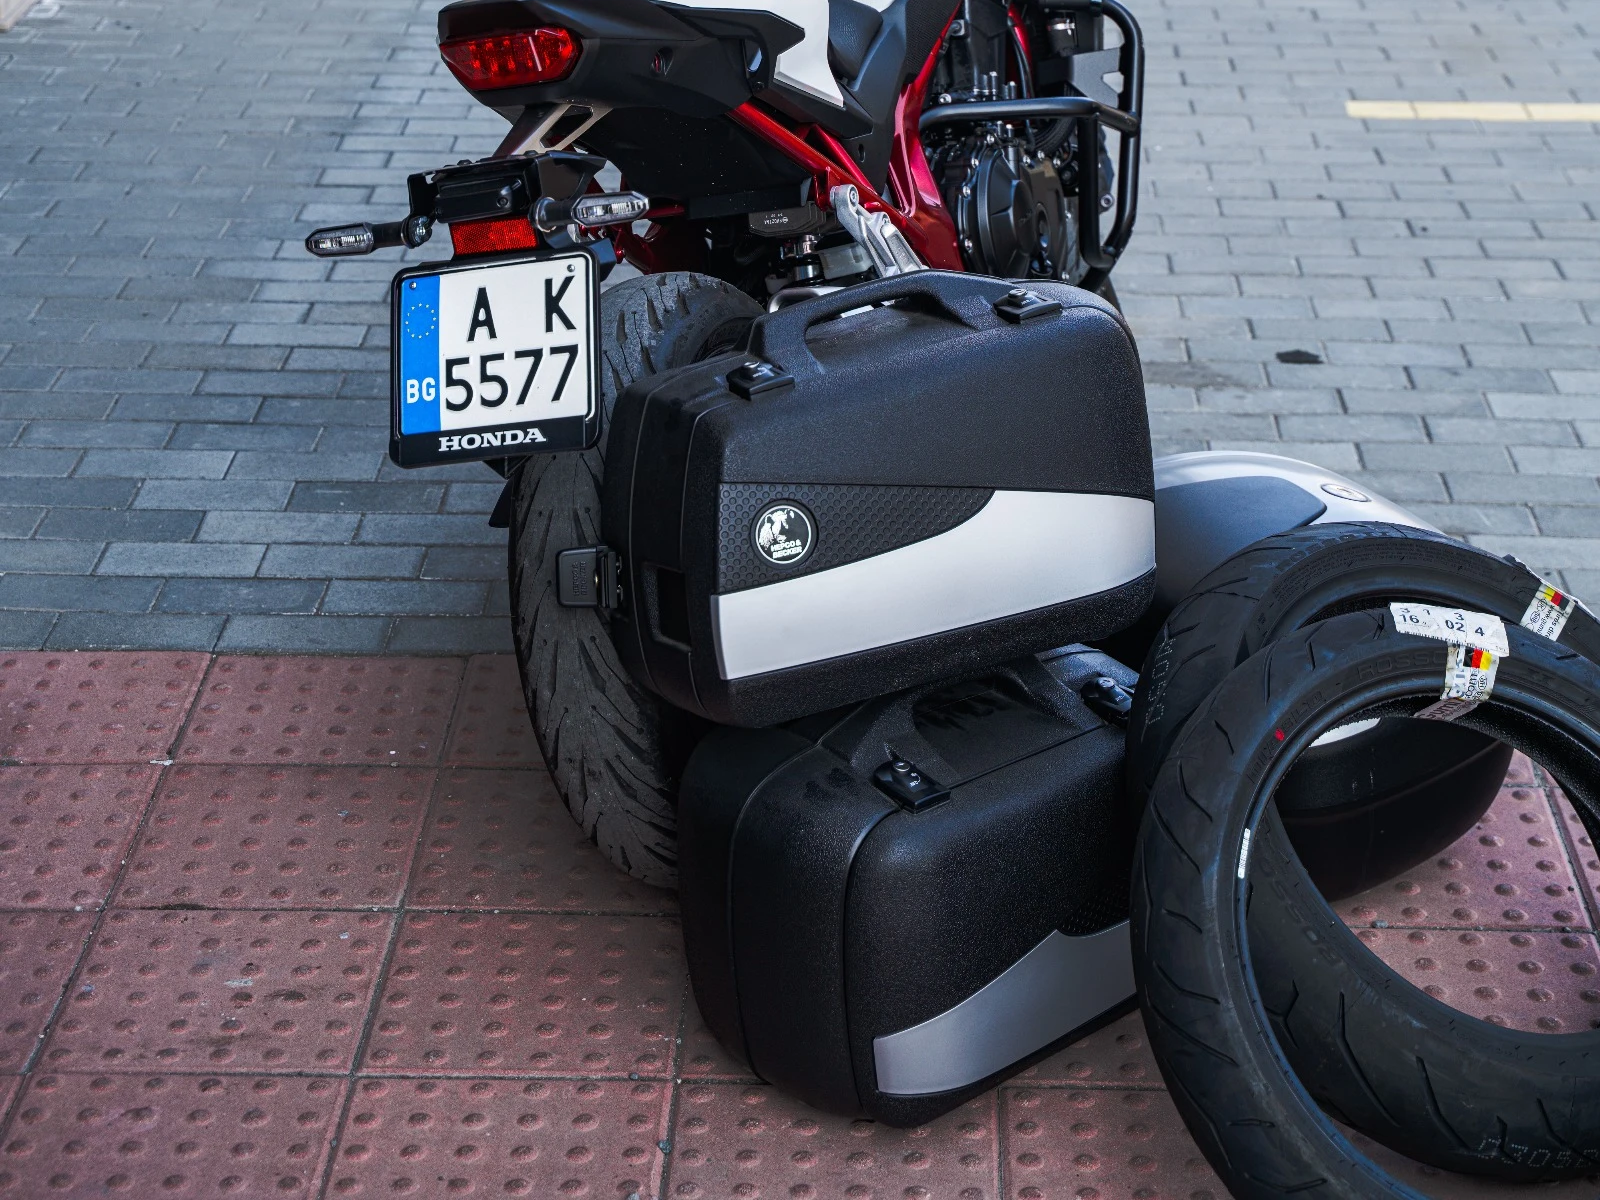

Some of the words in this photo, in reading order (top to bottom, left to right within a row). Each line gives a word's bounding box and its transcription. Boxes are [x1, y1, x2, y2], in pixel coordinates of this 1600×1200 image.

[467, 287, 497, 342] A
[545, 275, 576, 333] K
[445, 344, 578, 412] 5577
[406, 377, 436, 404] BG
[439, 428, 546, 451] HONDA
[771, 540, 795, 552] HEPCO
[773, 546, 802, 559] BECKER
[1445, 620, 1466, 633] 02
[1474, 627, 1485, 637] 4
